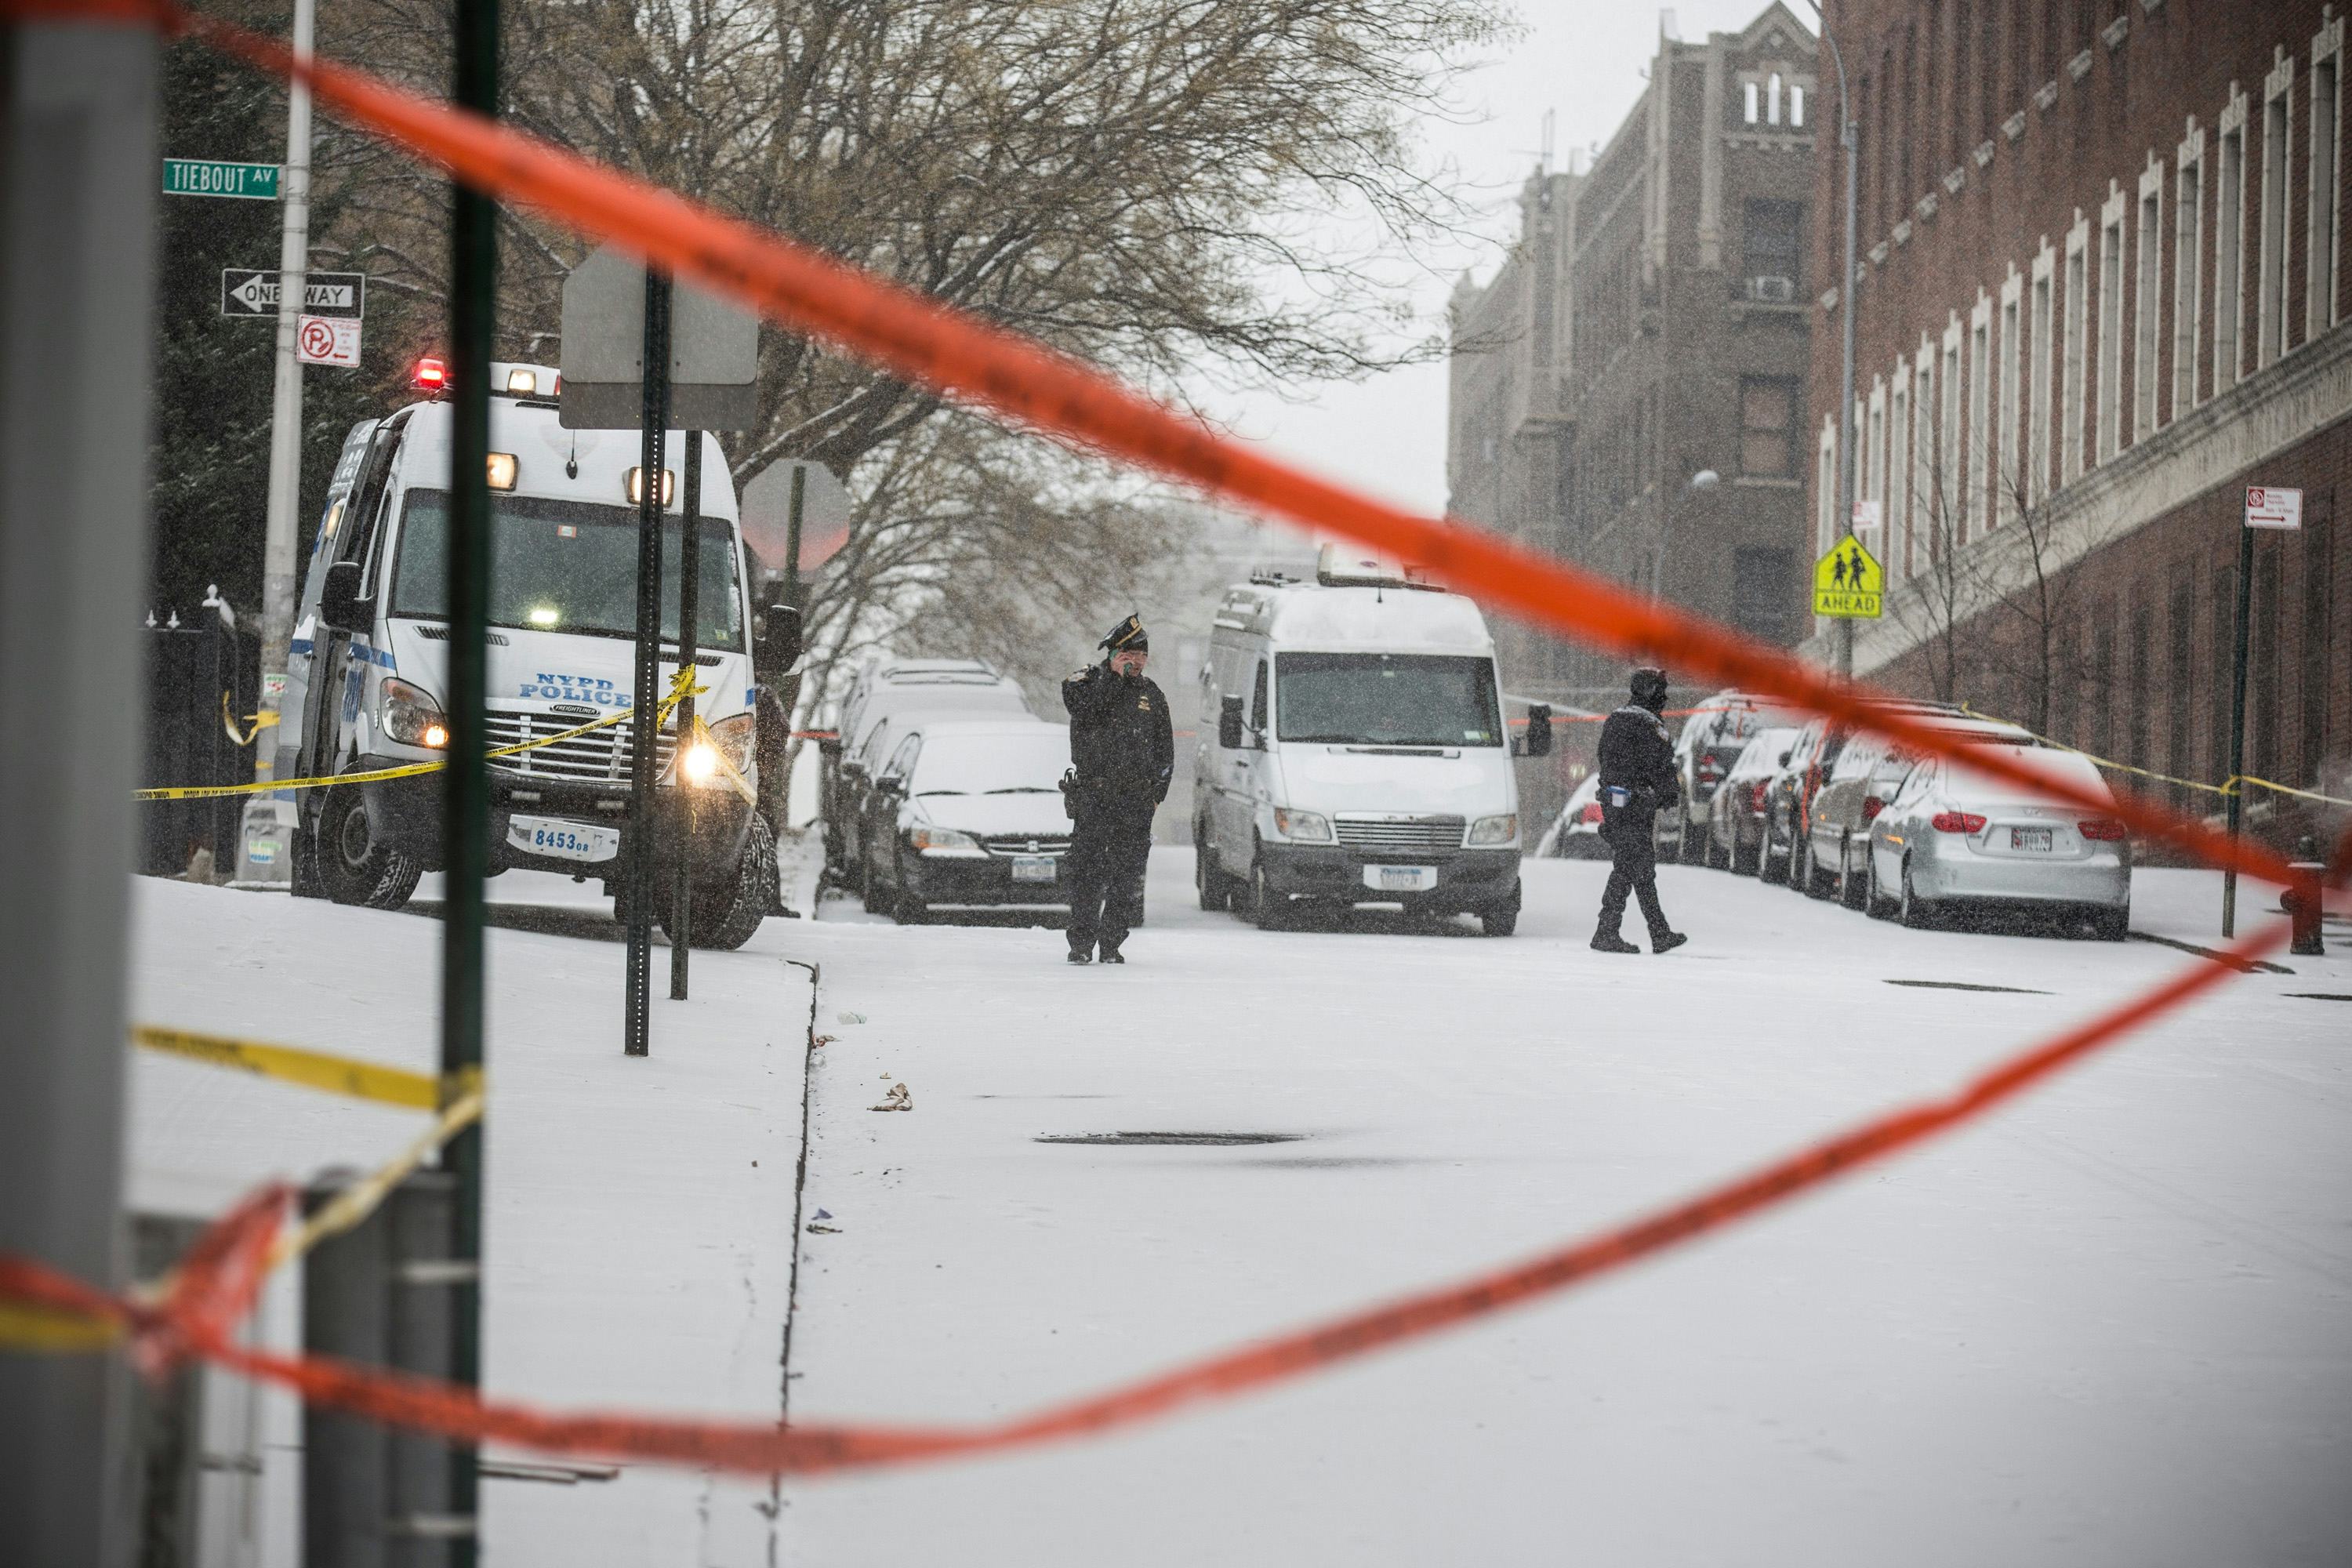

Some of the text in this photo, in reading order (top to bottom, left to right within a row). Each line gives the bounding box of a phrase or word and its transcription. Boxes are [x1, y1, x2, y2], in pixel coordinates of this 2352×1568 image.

[172, 164, 274, 193] TIEBOUT AV
[245, 285, 281, 302] ONE
[1821, 596, 1875, 612] AHEAD
[536, 673, 615, 691] NYPD
[520, 684, 632, 708] POLICE
[555, 704, 597, 715] FREIGHTLINER
